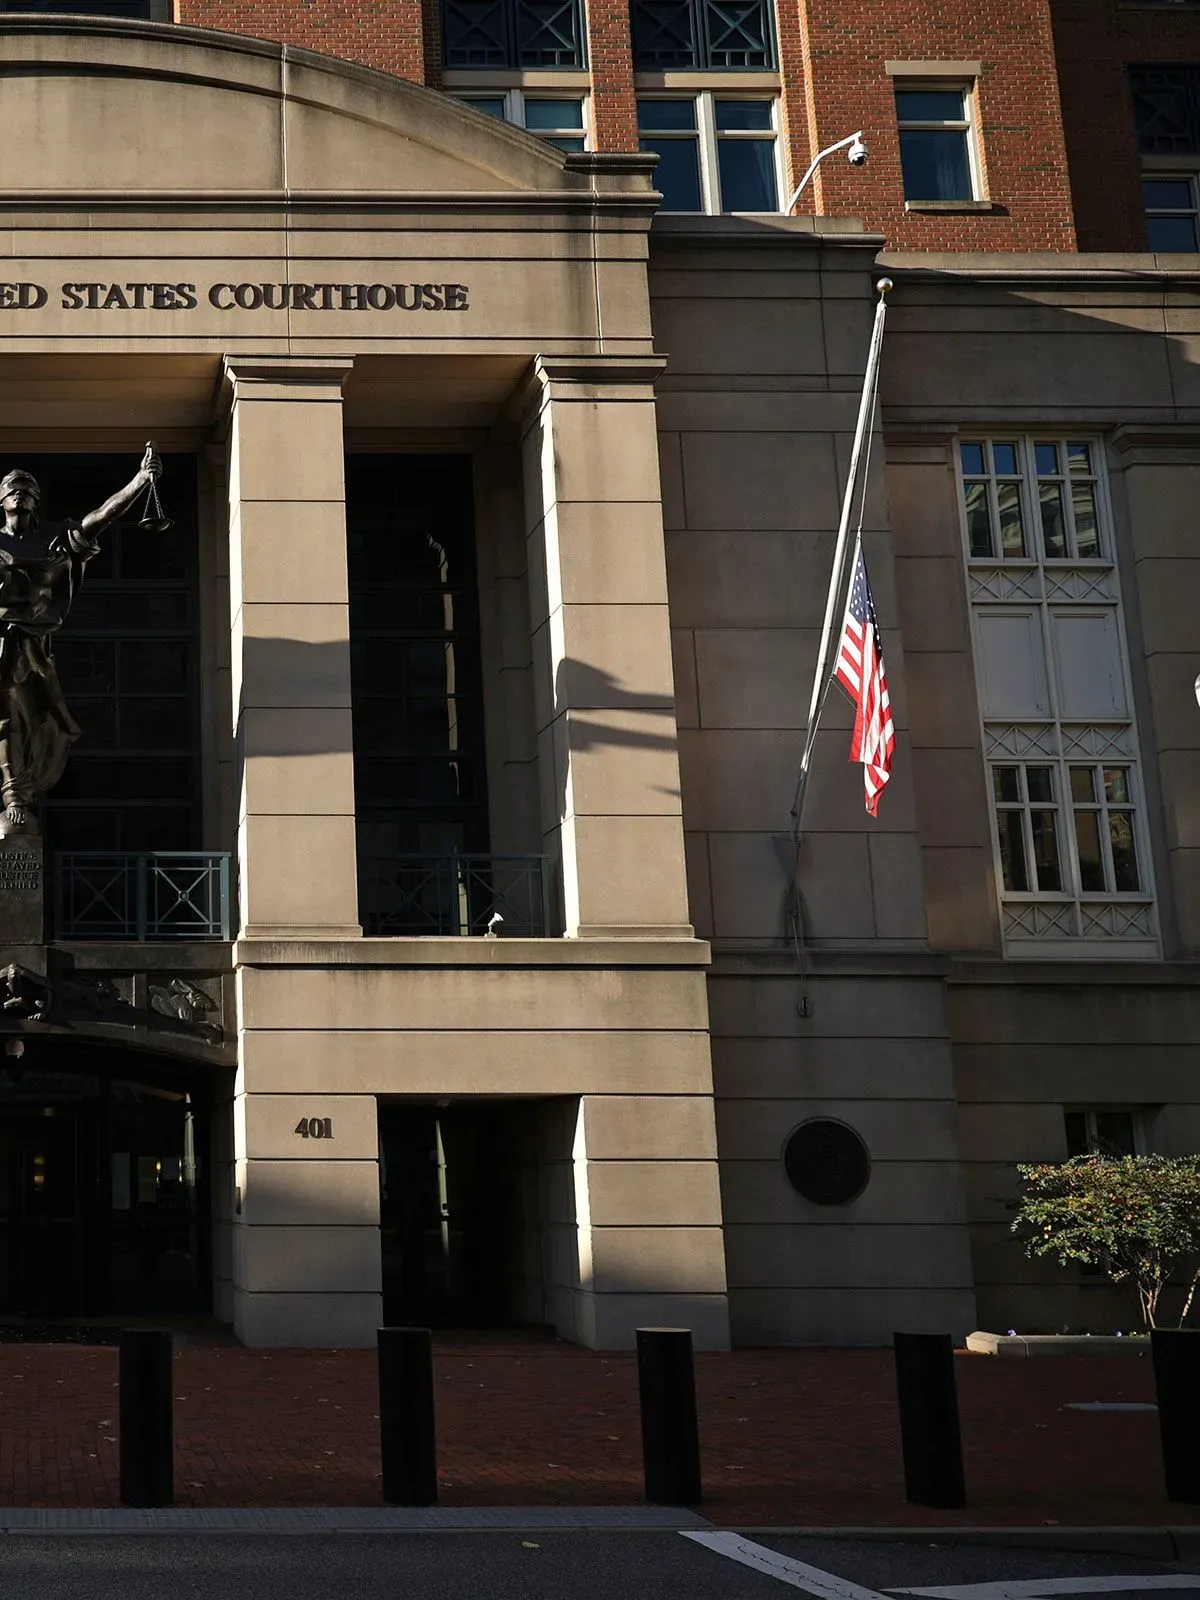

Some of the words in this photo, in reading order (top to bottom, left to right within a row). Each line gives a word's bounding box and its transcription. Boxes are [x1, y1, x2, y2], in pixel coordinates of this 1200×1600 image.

[62, 283, 198, 310] STATES
[209, 283, 470, 311] COURTHOUSE
[295, 1117, 335, 1139] 401
